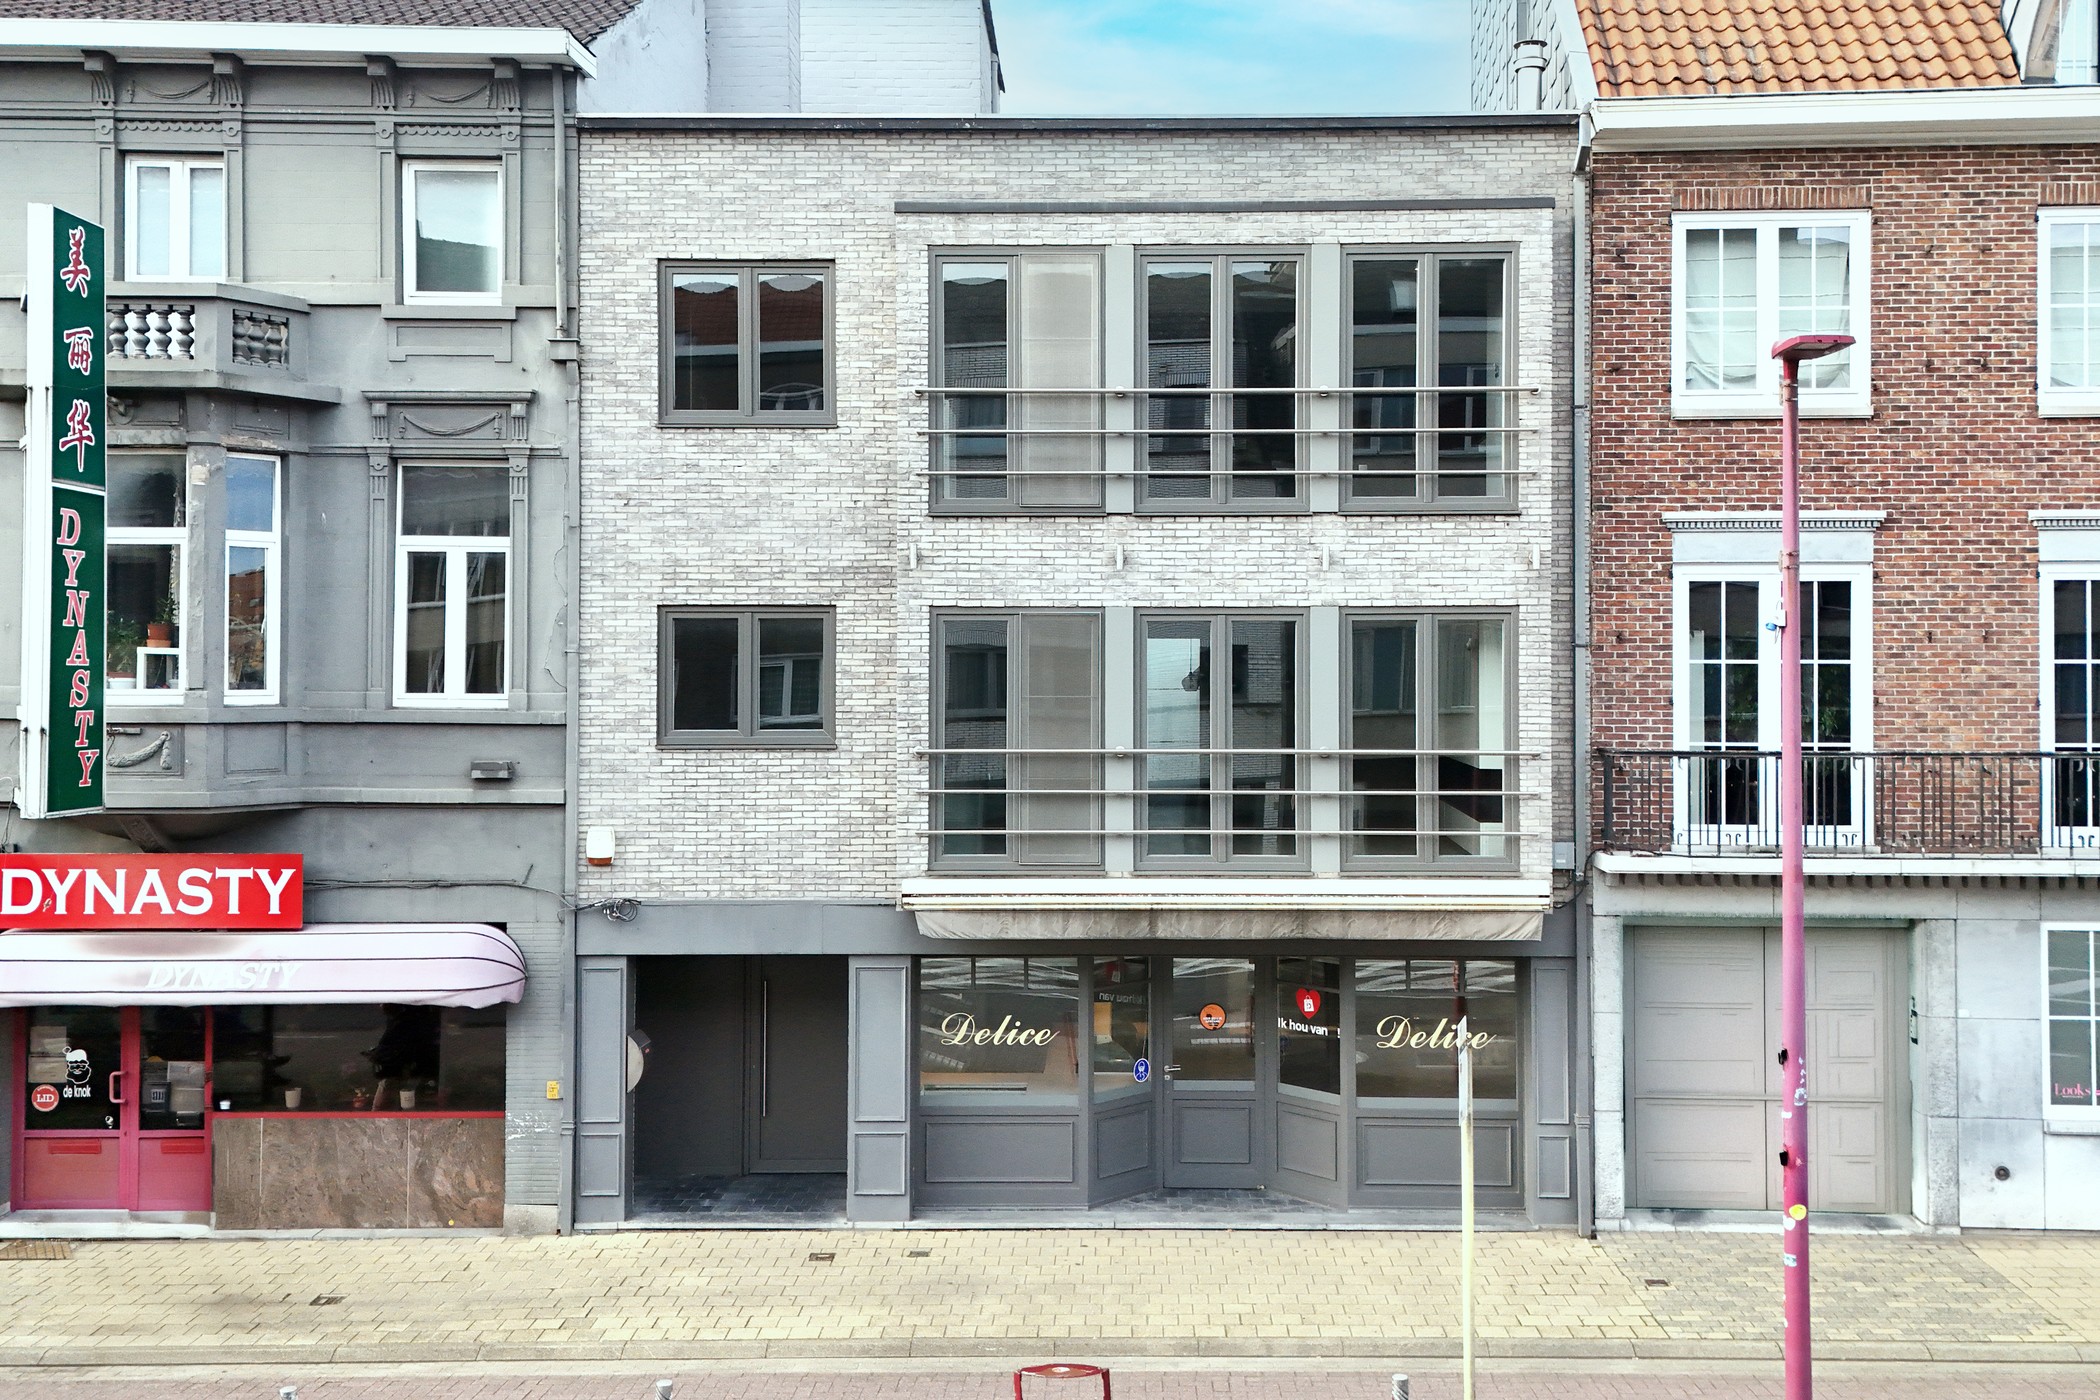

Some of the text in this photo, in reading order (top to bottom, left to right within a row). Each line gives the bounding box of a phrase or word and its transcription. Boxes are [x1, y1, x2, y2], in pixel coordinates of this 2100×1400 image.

[56, 508, 99, 787] DYNASTY
[0, 868, 297, 915] DYNASTY
[145, 963, 303, 989] DYNSTY
[941, 1012, 1060, 1046] Delice
[1277, 1017, 1288, 1029] Ik
[1289, 1019, 1309, 1033] hou
[1310, 1025, 1329, 1036] van
[63, 1085, 73, 1098] de
[74, 1085, 91, 1098] knok
[2054, 1083, 2091, 1096] Looks
